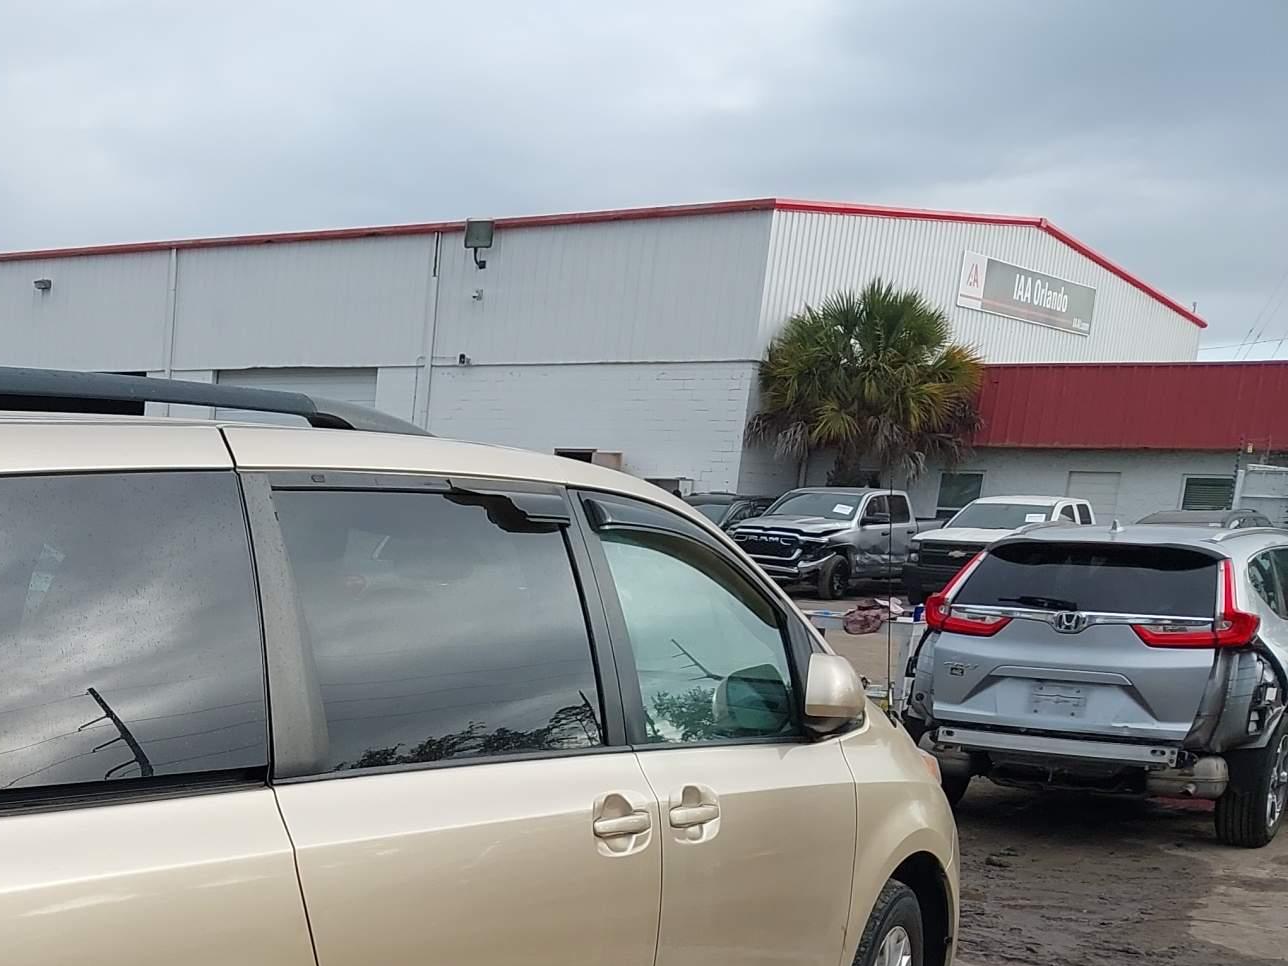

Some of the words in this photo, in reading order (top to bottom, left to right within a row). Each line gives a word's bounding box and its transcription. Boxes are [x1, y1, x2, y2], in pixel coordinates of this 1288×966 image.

[1013, 273, 1033, 304] IAA
[1033, 279, 1068, 313] Orlando
[748, 534, 780, 543] RAM
